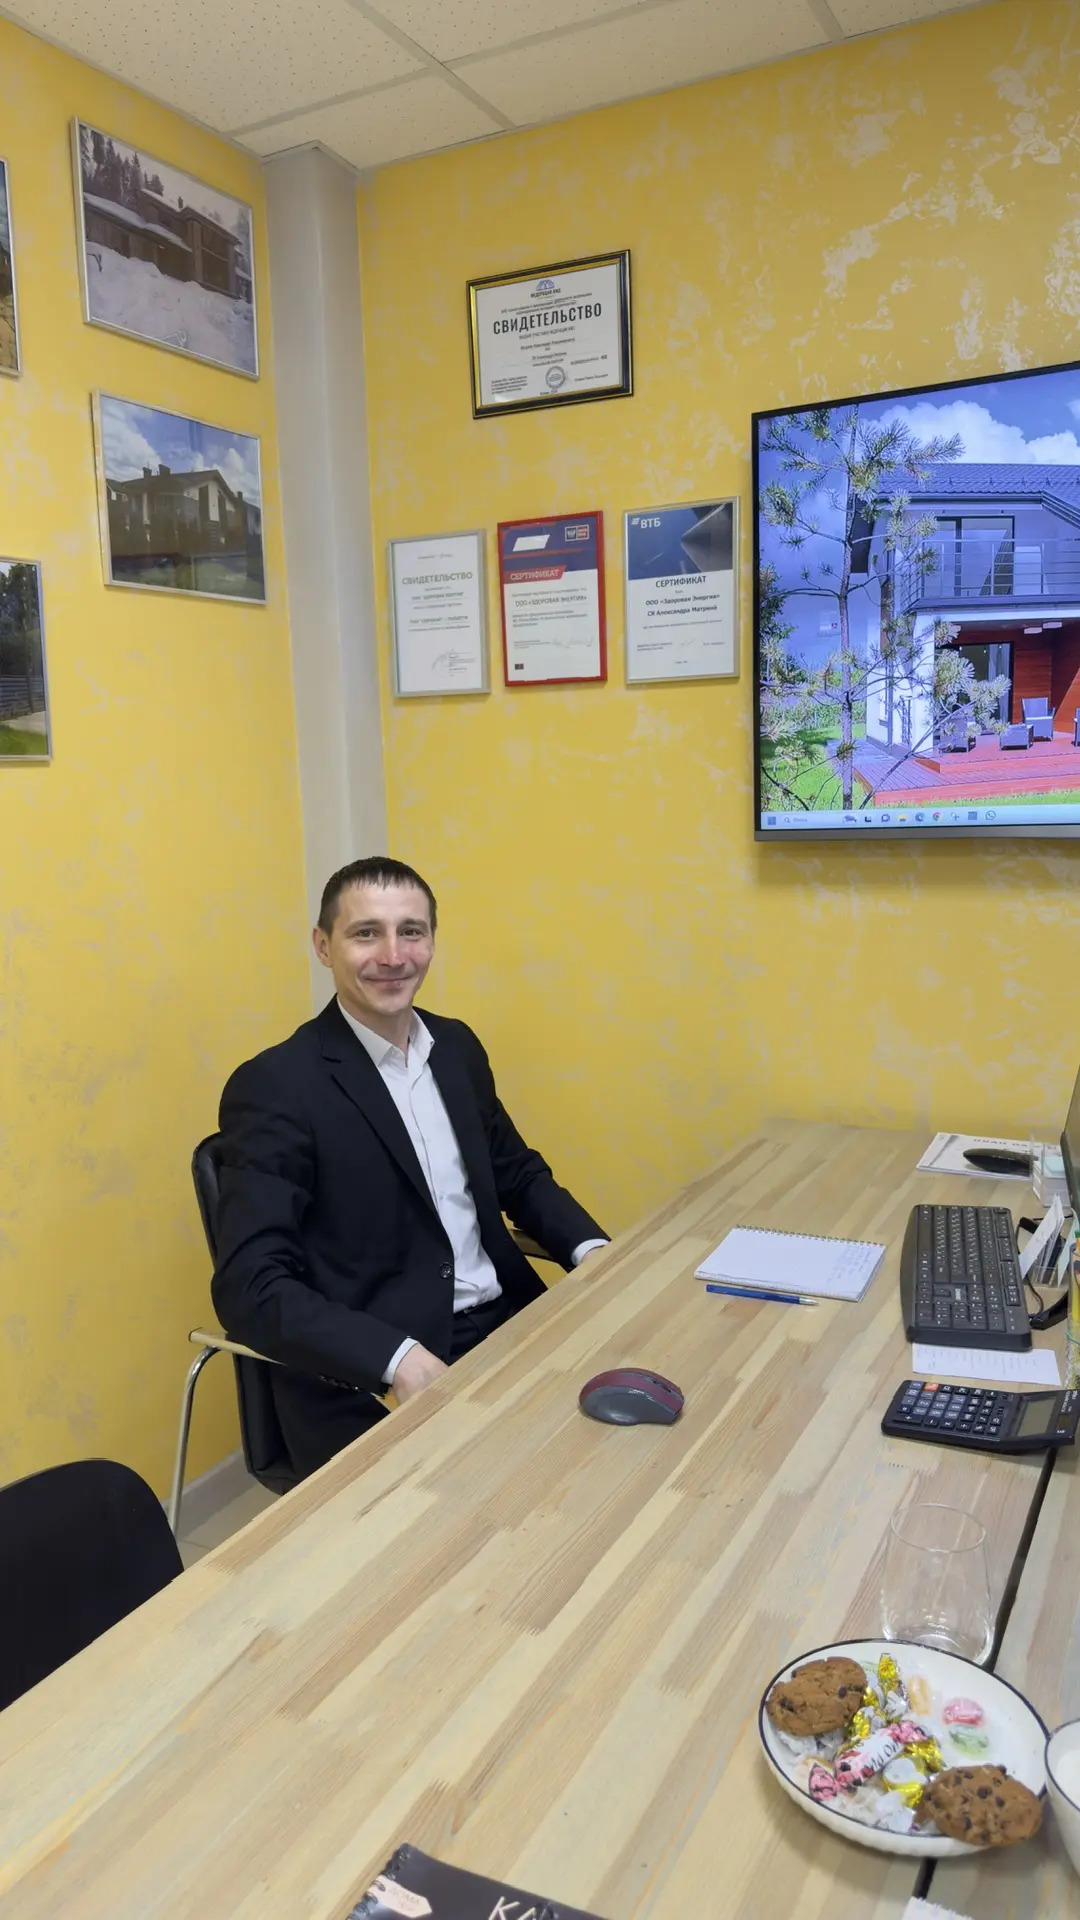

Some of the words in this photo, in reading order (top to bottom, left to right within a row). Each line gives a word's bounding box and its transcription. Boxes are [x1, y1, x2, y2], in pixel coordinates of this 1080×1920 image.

[493, 303, 602, 334] СВИДЕТЕЛЬСТВО
[640, 517, 661, 529] ВТБ
[402, 572, 473, 585] СВИДЕТЕЛЬСТВО
[510, 569, 560, 581] СЕРТИФИКАТ
[655, 575, 707, 588] СЕРТИФИКАТ
